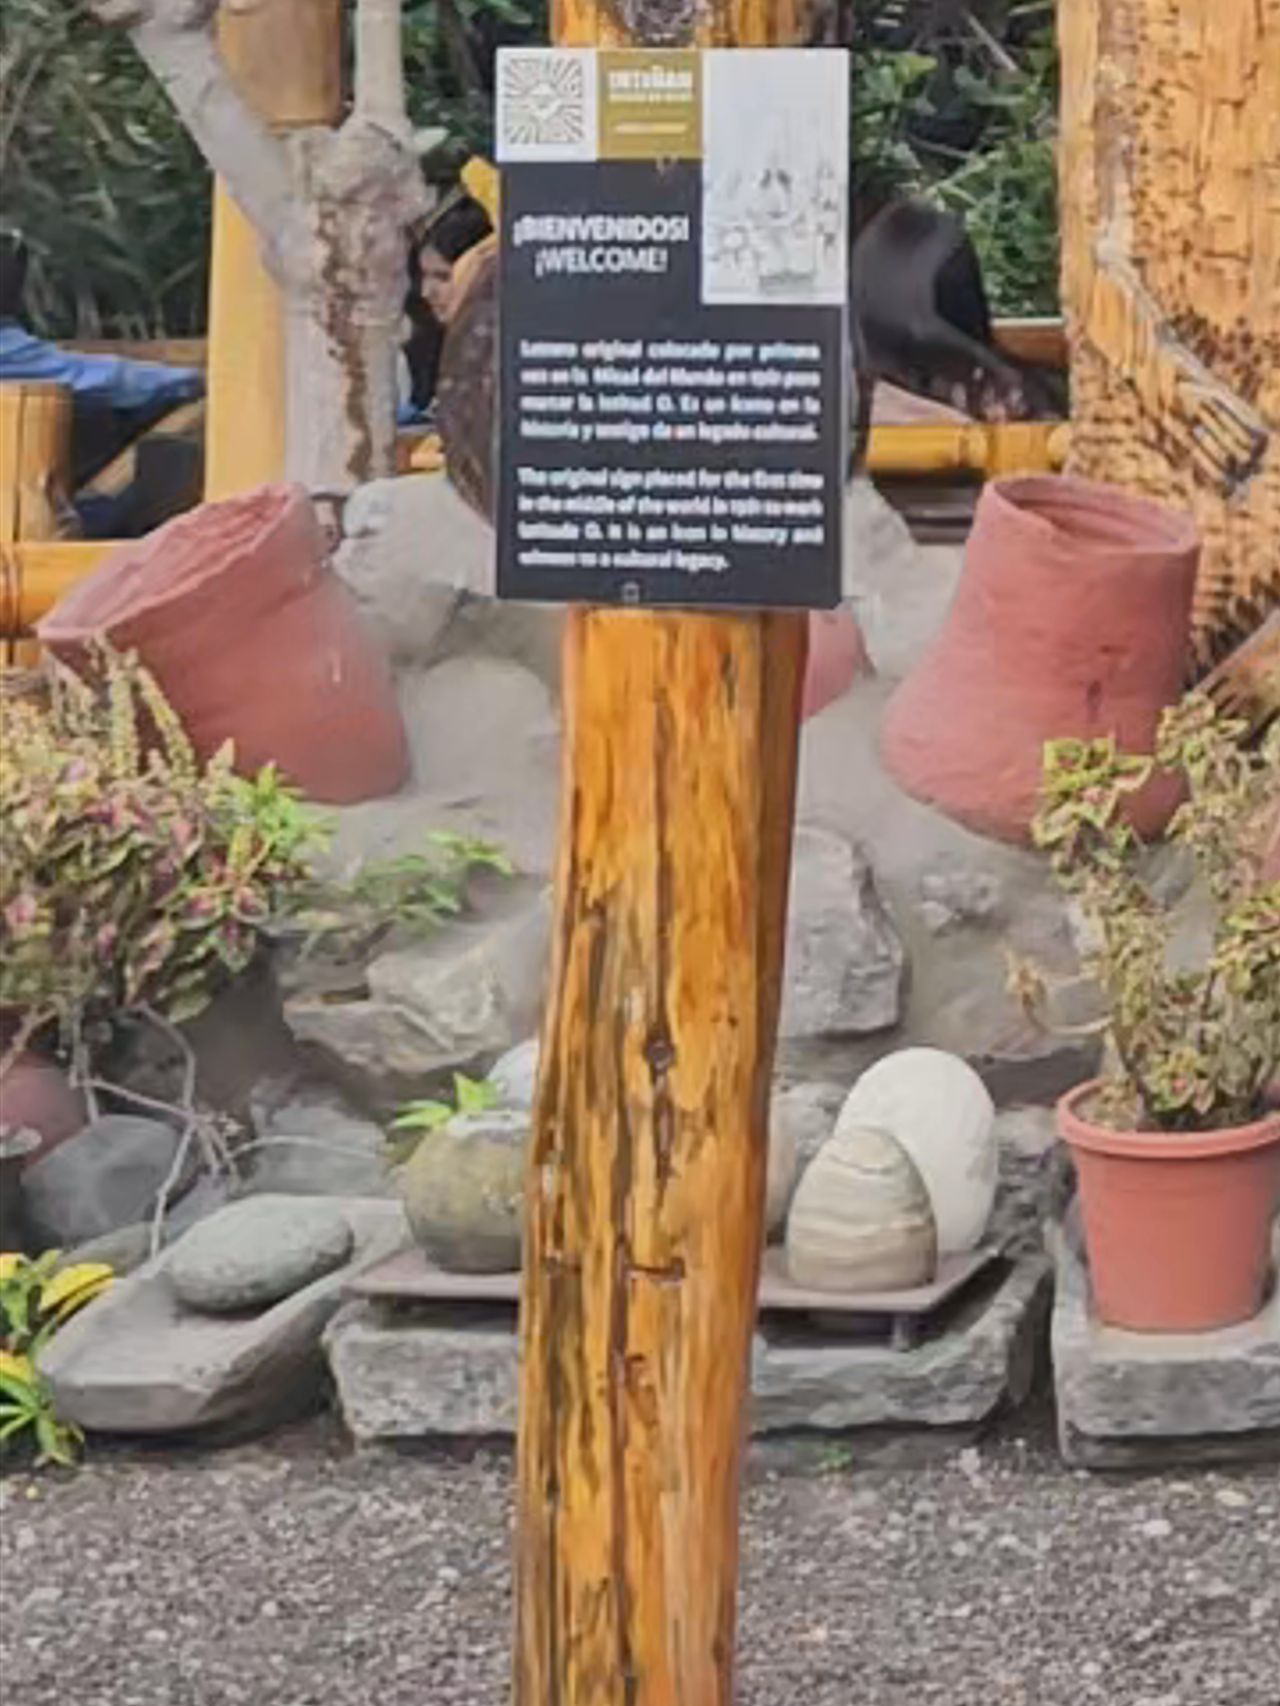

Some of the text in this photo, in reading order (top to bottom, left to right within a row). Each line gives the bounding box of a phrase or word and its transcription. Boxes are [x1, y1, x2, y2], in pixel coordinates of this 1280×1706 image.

[513, 215, 690, 247] ¡BIENVENIDOS!
[535, 247, 668, 276] ¡WELCOME!
[581, 340, 643, 362] original
[549, 467, 607, 490] original
